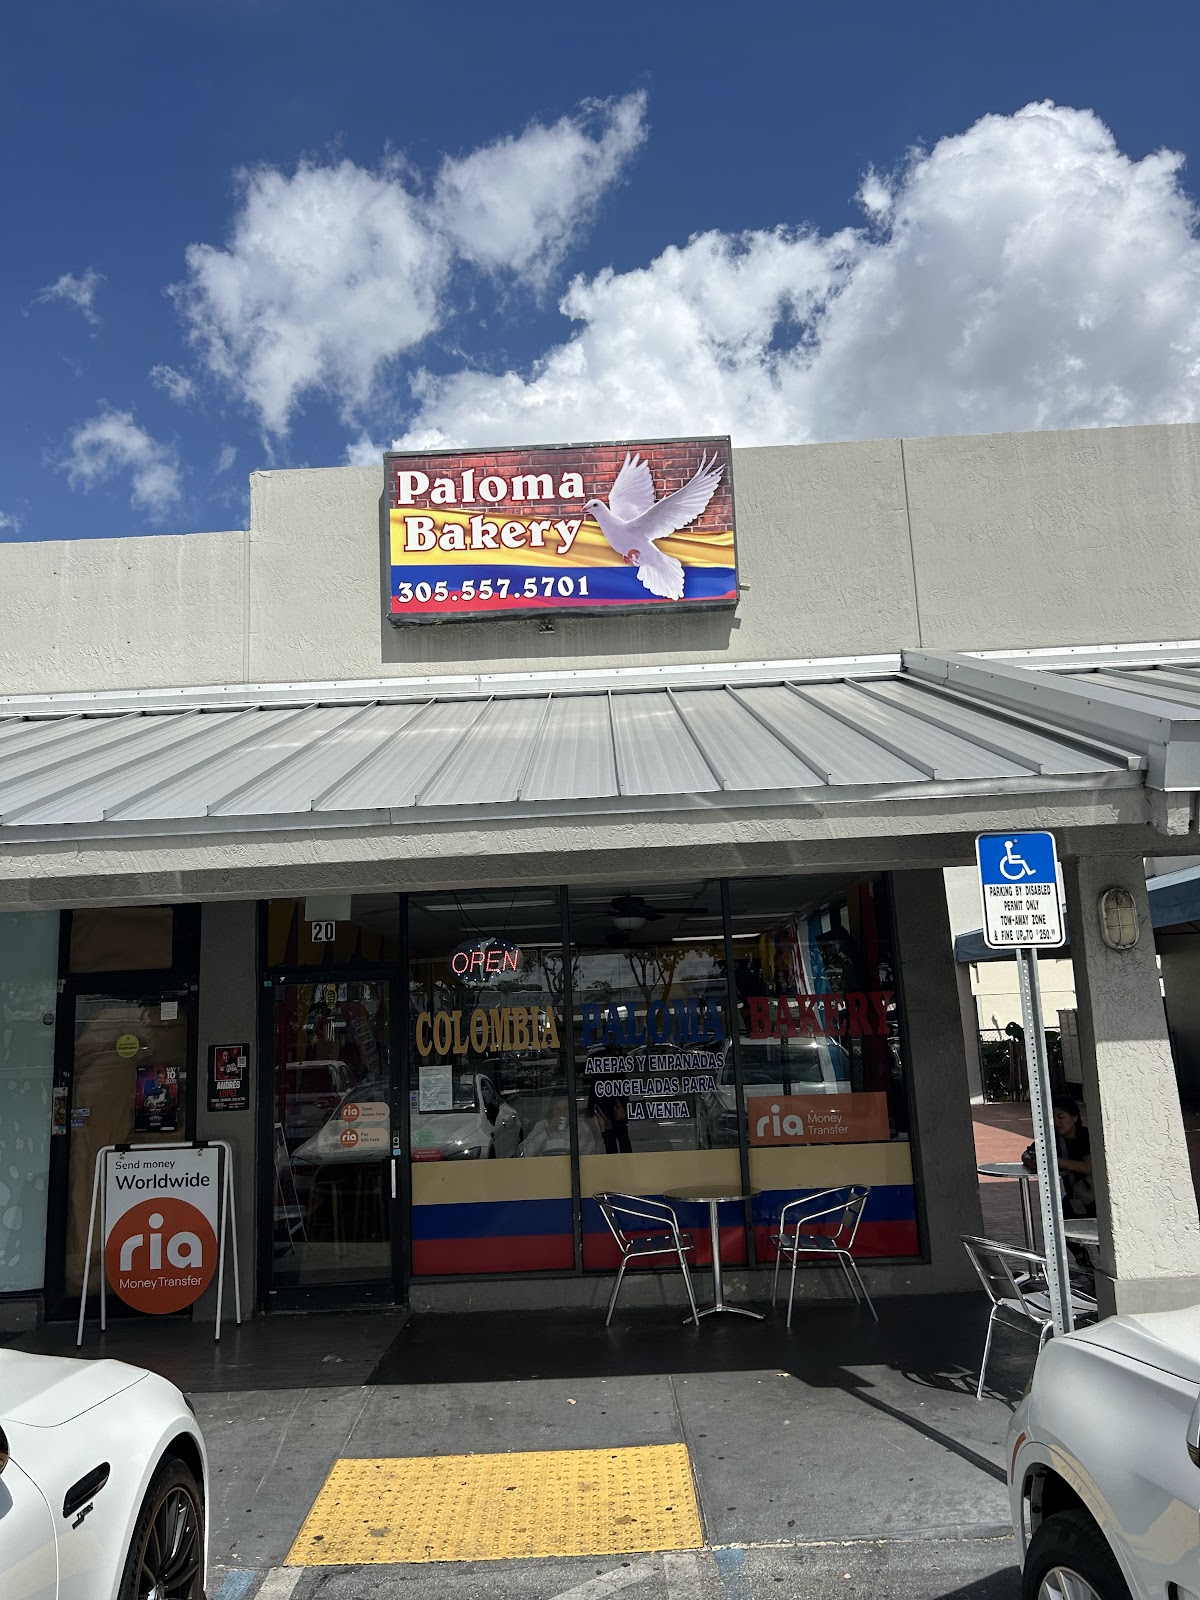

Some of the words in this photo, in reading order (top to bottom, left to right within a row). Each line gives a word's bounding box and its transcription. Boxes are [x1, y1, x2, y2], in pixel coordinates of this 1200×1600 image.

[397, 468, 586, 505] Paloma
[403, 514, 585, 554] Bakery
[398, 575, 589, 603] 305.557.5701
[989, 886, 1013, 897] PARKING
[1015, 886, 1022, 896] BY
[1025, 885, 1051, 896] DISABLED
[1003, 900, 1023, 911] PERMIT
[1025, 900, 1039, 910] ONLY
[1000, 915, 1029, 926] TOW-AWAY
[1032, 914, 1046, 925] ZONE
[313, 922, 334, 941] 20
[1001, 930, 1014, 941] FINE
[1016, 930, 1024, 940] UP
[1025, 929, 1033, 940] TO
[451, 949, 519, 974] OPEN
[580, 998, 724, 1047] PALOMA
[747, 991, 893, 1040] BAKERY
[416, 1005, 561, 1057] COLOMBIA
[585, 1054, 635, 1074] AREPAS
[636, 1054, 647, 1072] Y
[649, 1052, 725, 1071] EMPANADAS
[167, 1071, 176, 1079] 10
[594, 1077, 680, 1098] CONGELADAS
[682, 1075, 716, 1094] PARA
[343, 1105, 358, 1116] ria
[627, 1102, 645, 1121] LA
[646, 1101, 690, 1119] VENTA
[756, 1103, 804, 1137] ria
[808, 1114, 843, 1124] Money
[342, 1130, 357, 1142] ria
[808, 1125, 849, 1135] Transfer
[115, 1160, 140, 1170] Send
[143, 1160, 176, 1169] money
[115, 1172, 210, 1190] Worldwide
[119, 1212, 203, 1272] ria
[119, 1278, 157, 1290] Money
[158, 1275, 203, 1287] Transfer
